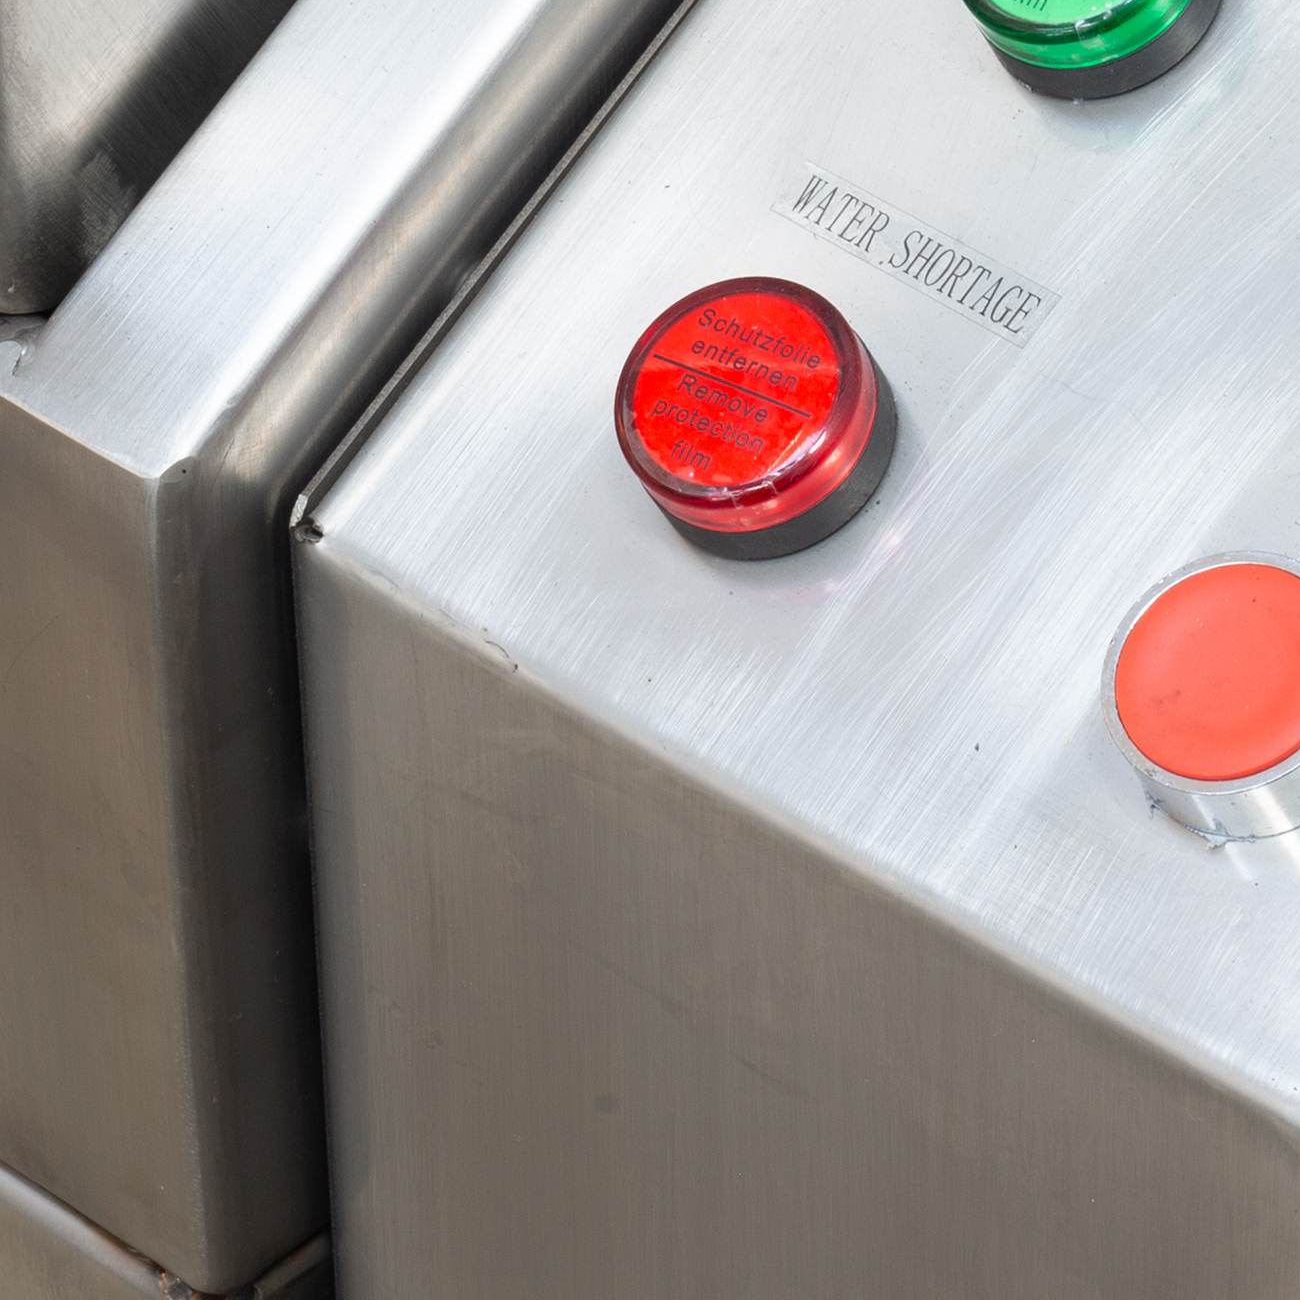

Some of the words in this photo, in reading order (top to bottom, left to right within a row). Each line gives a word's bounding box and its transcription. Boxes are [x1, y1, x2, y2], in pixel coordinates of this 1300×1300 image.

[792, 175, 890, 252] WATER
[889, 230, 1042, 334] SHORTAGE
[697, 308, 821, 369] Schutzfolie
[691, 340, 798, 391] entfernen
[677, 374, 768, 423] Remove
[651, 399, 764, 454] protection
[670, 440, 711, 471] film
